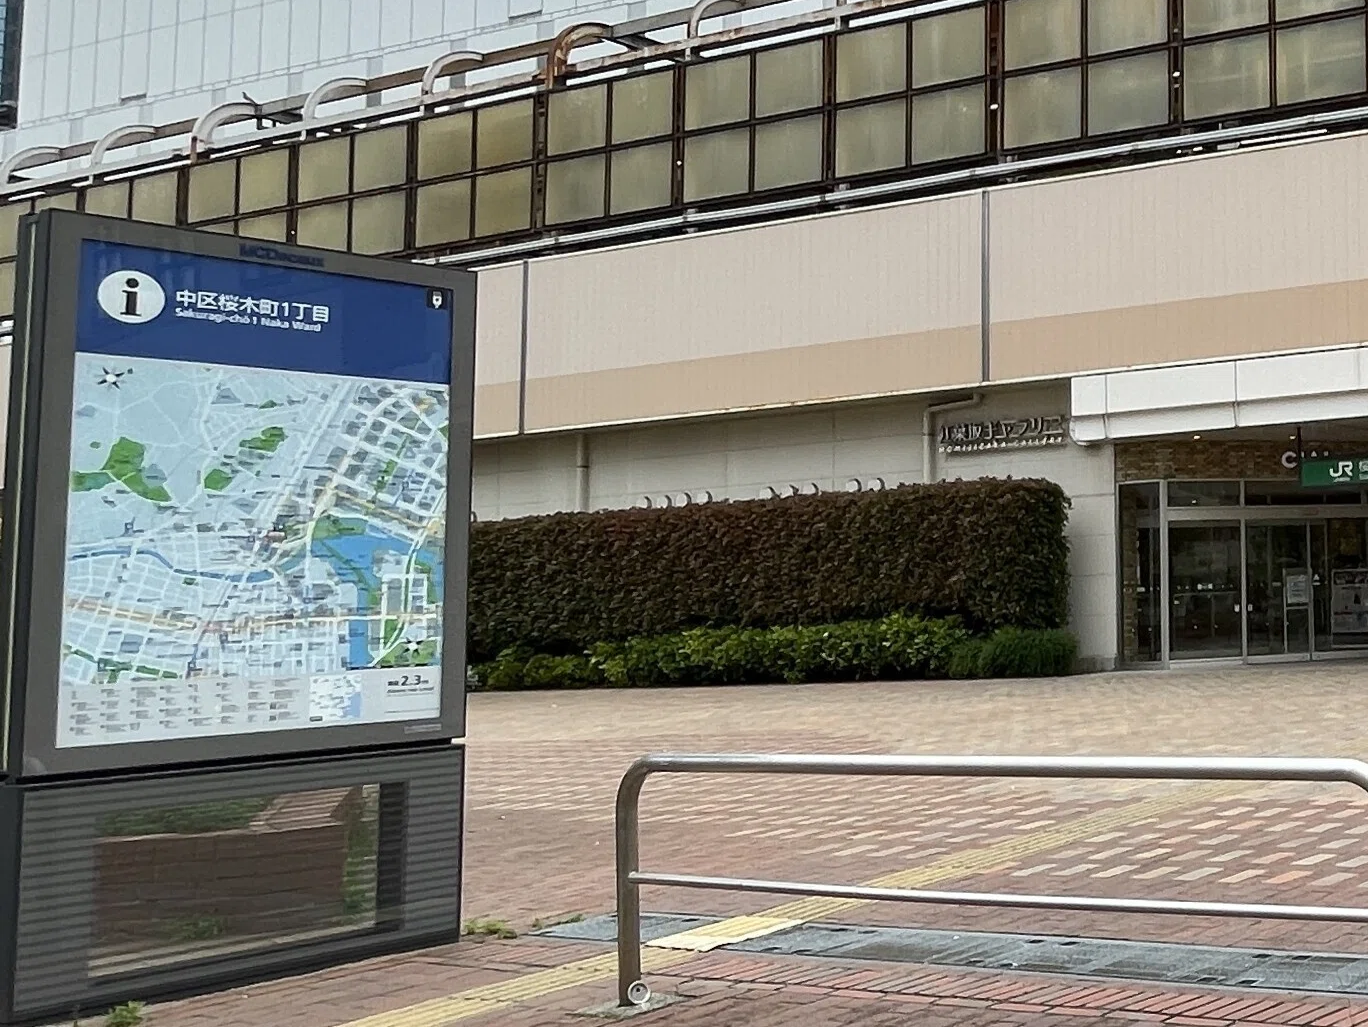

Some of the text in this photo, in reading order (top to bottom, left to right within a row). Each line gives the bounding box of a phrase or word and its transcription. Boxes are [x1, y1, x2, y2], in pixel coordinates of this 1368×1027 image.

[175, 289, 330, 323] 中区桜木町1丁目
[1328, 460, 1354, 478] JR
